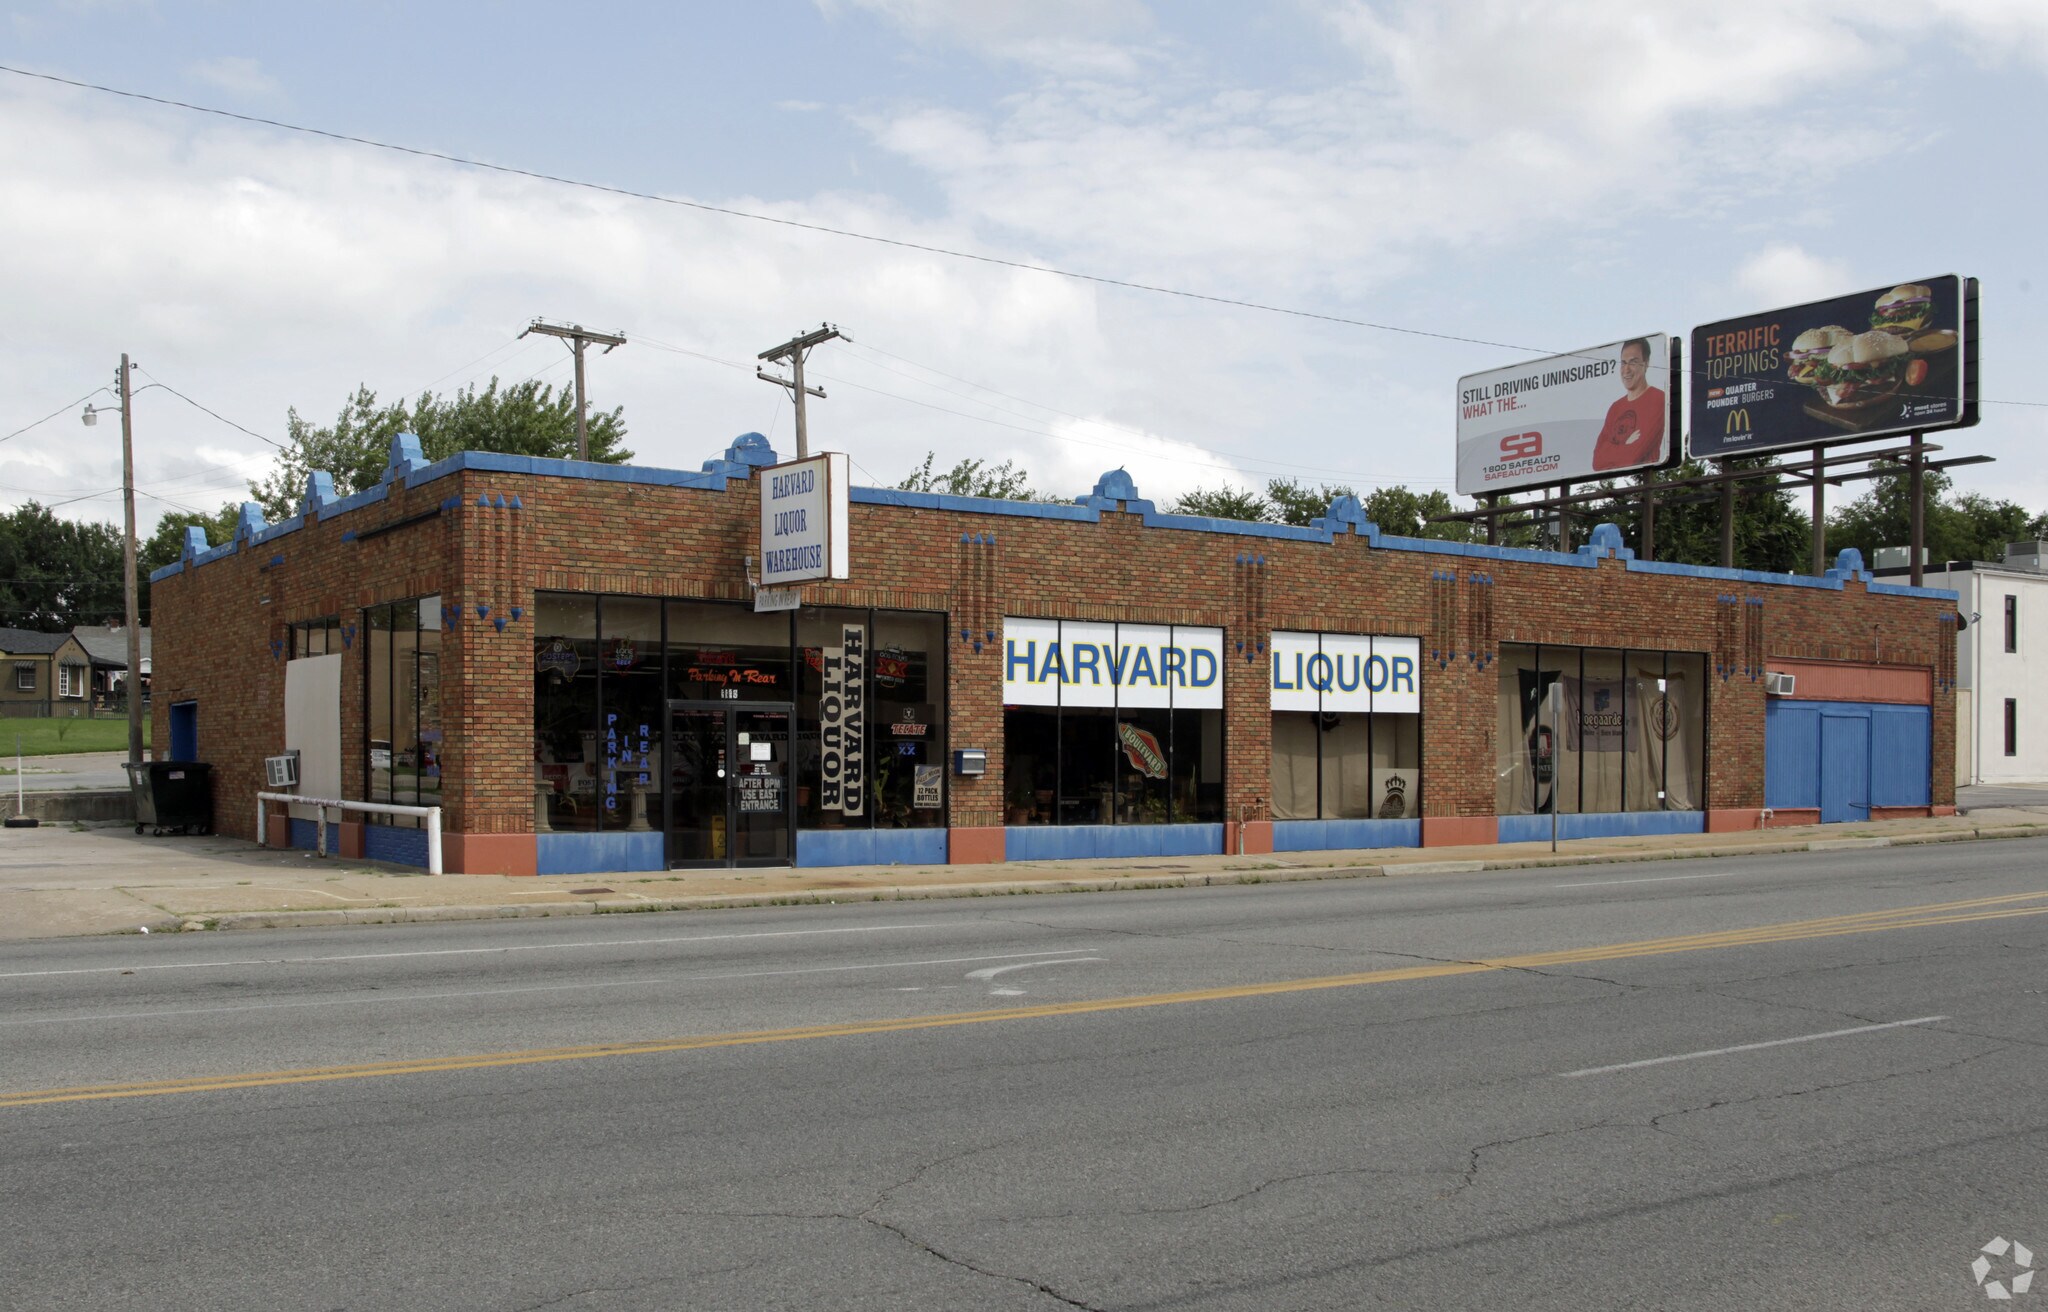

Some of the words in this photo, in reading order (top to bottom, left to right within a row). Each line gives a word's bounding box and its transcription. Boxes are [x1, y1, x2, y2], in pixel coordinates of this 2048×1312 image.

[1707, 324, 1781, 358] TERRIFIC
[1706, 348, 1780, 381] TOPPINGS
[1463, 386, 1491, 404] STILL
[1494, 375, 1539, 398] DRIVING
[1542, 359, 1617, 388] UNINSURED?
[1725, 382, 1757, 396] QUARTER
[1463, 401, 1493, 420] WHAT
[1496, 396, 1527, 413] THE...
[1707, 396, 1739, 409] POUNDER
[1742, 389, 1774, 404] BURGERS
[1484, 463, 1559, 481] SAFEAUTO.COM
[1508, 454, 1561, 470] SAFEAUTO
[772, 469, 815, 500] HARVARD
[774, 509, 807, 536] LIQUOR
[766, 545, 822, 574] WAREHOUSE
[758, 594, 779, 608] PARKING
[1005, 638, 1219, 688] HARVARD
[1272, 650, 1416, 695] LIQUOR
[687, 667, 728, 688] Parking
[743, 669, 777, 685] Rear
[819, 656, 842, 806] LIQUOR
[844, 629, 863, 811] HARVARD
[891, 723, 928, 736] TECATE
[606, 713, 617, 809] PARKING
[622, 735, 633, 765] IN
[640, 724, 650, 785] REAR
[1124, 729, 1162, 772] BOULEVARD
[739, 778, 761, 789] AFTER
[742, 789, 757, 800] USE
[759, 789, 778, 800] EAST
[741, 800, 779, 811] ENTRANCE
[917, 794, 939, 802] BOTTLES
